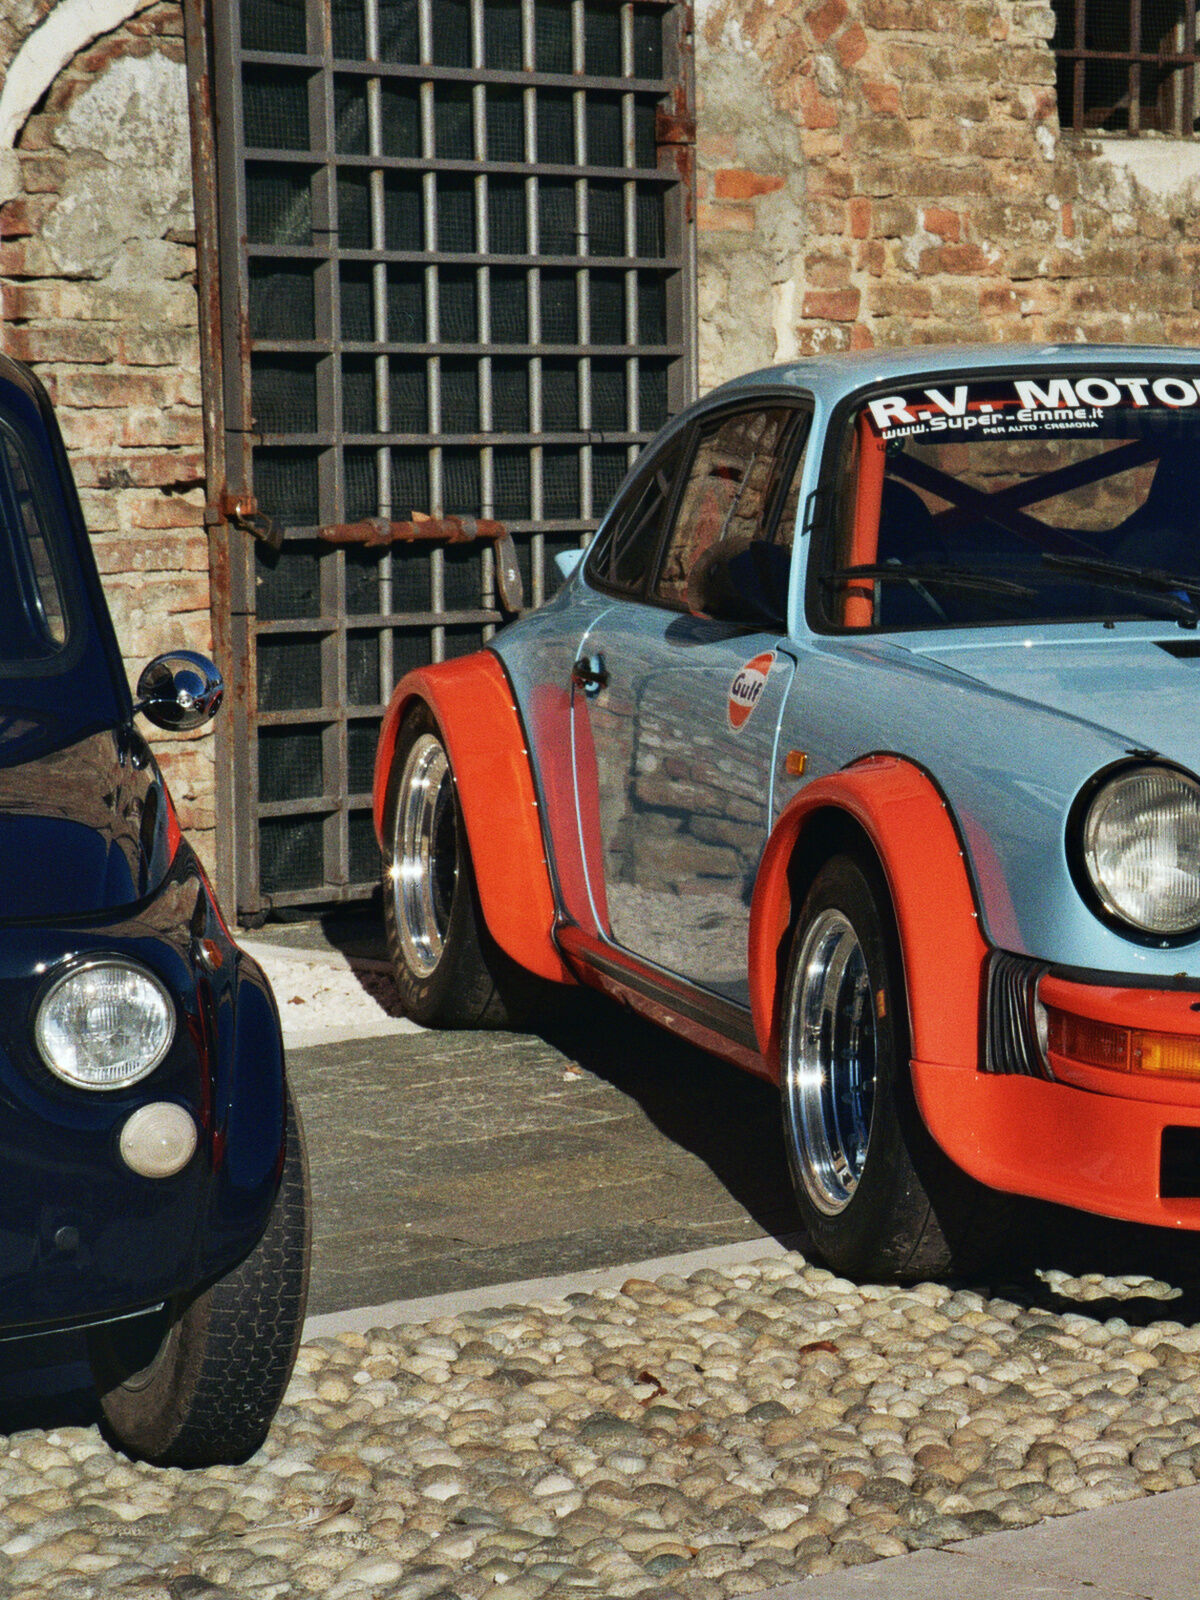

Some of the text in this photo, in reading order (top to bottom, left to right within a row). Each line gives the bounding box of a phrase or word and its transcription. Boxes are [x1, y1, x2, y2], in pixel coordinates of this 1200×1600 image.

[868, 385, 994, 429] R.V.
[882, 407, 1104, 440] www.Super-Emme.it
[983, 426, 1006, 435] PER
[1008, 424, 1038, 433] AUTO
[1044, 420, 1099, 431] CREMONA
[732, 672, 763, 702] Gulf
